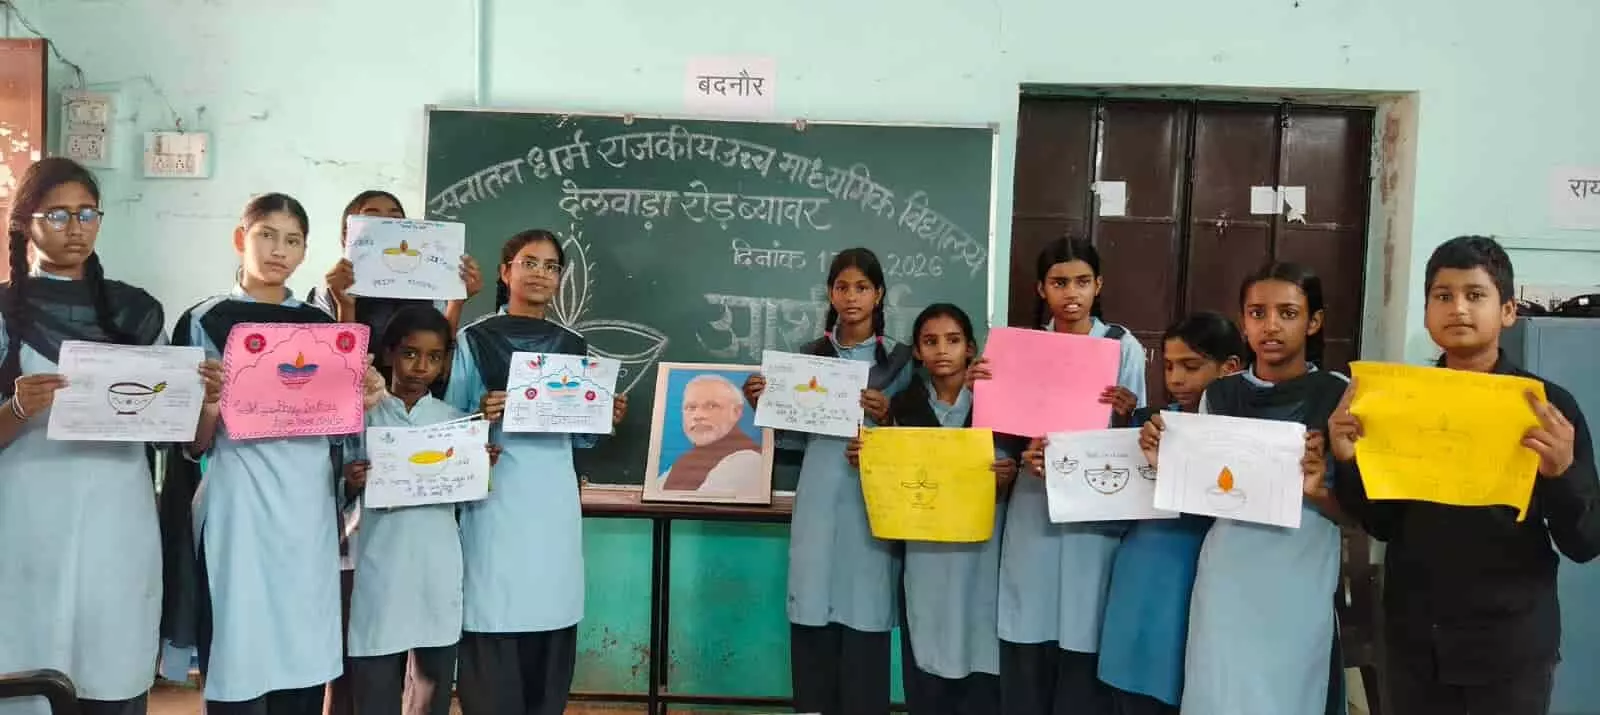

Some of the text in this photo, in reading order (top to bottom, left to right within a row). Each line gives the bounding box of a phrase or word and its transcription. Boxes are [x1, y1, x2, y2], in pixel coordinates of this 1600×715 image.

[696, 69, 765, 96] बदनौर
[427, 159, 525, 219] सनातन
[527, 129, 592, 179] धर्म
[597, 125, 722, 168] राजकीय
[738, 195, 832, 231] ब्यावर
[732, 239, 806, 268] दिनांक
